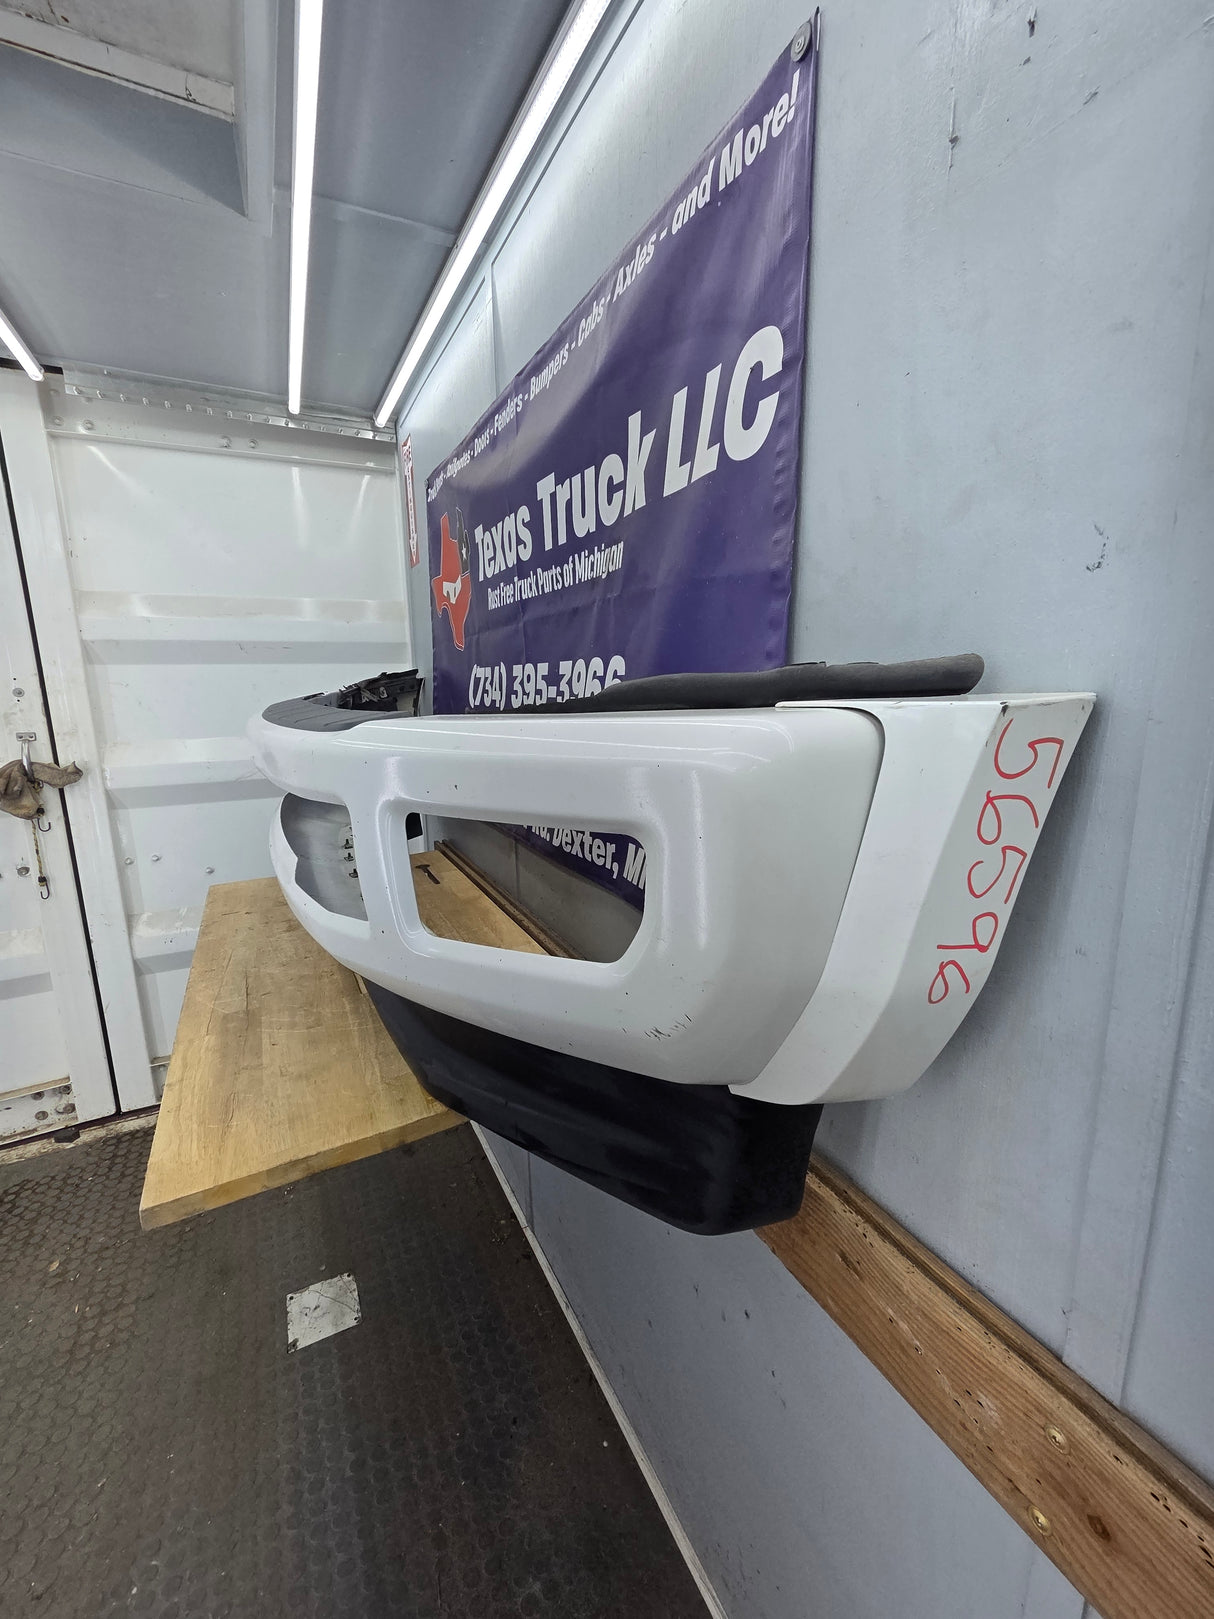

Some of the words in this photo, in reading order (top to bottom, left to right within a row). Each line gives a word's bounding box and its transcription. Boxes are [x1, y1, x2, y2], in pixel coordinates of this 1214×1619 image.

[474, 428, 490, 457] Doors
[494, 393, 523, 436] Fenders
[530, 342, 569, 401] Bumpers
[578, 297, 605, 348] Cabs
[612, 232, 657, 303] Axles
[671, 159, 716, 235] and
[718, 67, 800, 192] More!
[474, 505, 533, 582] Texas
[536, 410, 657, 551] Truck
[663, 325, 784, 498] LLC
[487, 586, 501, 611] Rust
[500, 581, 514, 607] Free
[513, 570, 539, 602] Truck
[537, 564, 563, 595] Parts
[563, 555, 574, 588] of
[575, 541, 624, 584] Michigan
[468, 661, 507, 712] (734)
[510, 655, 626, 709] 395-3966
[927, 718, 1064, 1005] 56596
